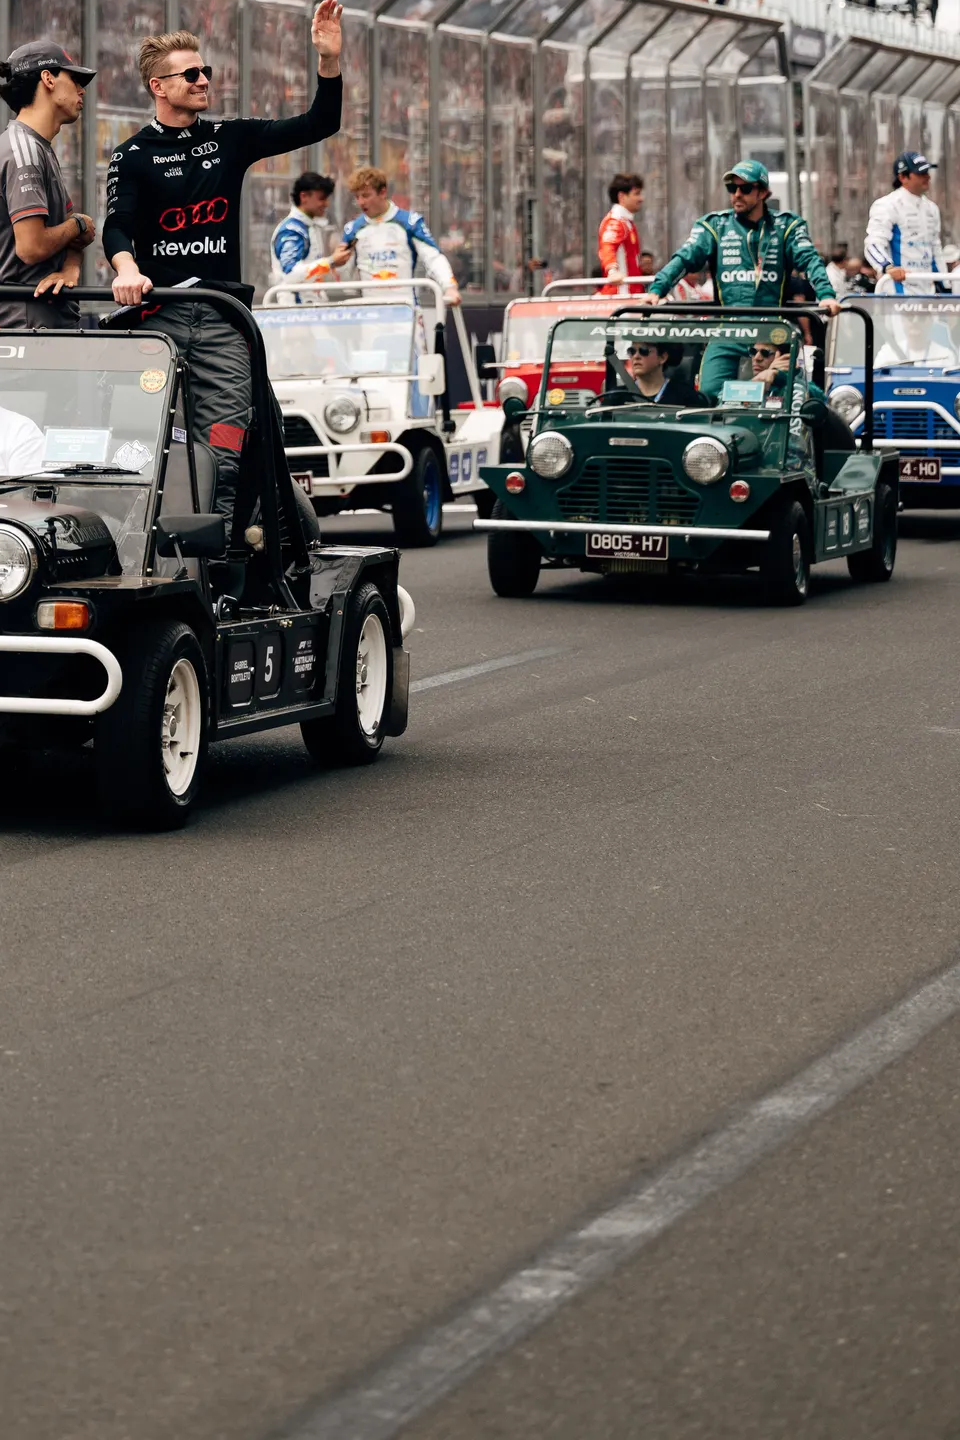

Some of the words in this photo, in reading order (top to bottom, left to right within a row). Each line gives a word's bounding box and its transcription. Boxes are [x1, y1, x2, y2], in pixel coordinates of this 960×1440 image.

[153, 153, 186, 164] Revolut
[152, 236, 227, 256] Revolut
[258, 315, 318, 324] ACING
[590, 326, 666, 337] ASTON
[669, 327, 759, 338] MARTIN
[234, 660, 249, 671] GABRIEL
[265, 646, 273, 682] 5
[231, 671, 251, 684] BORTOLETO
